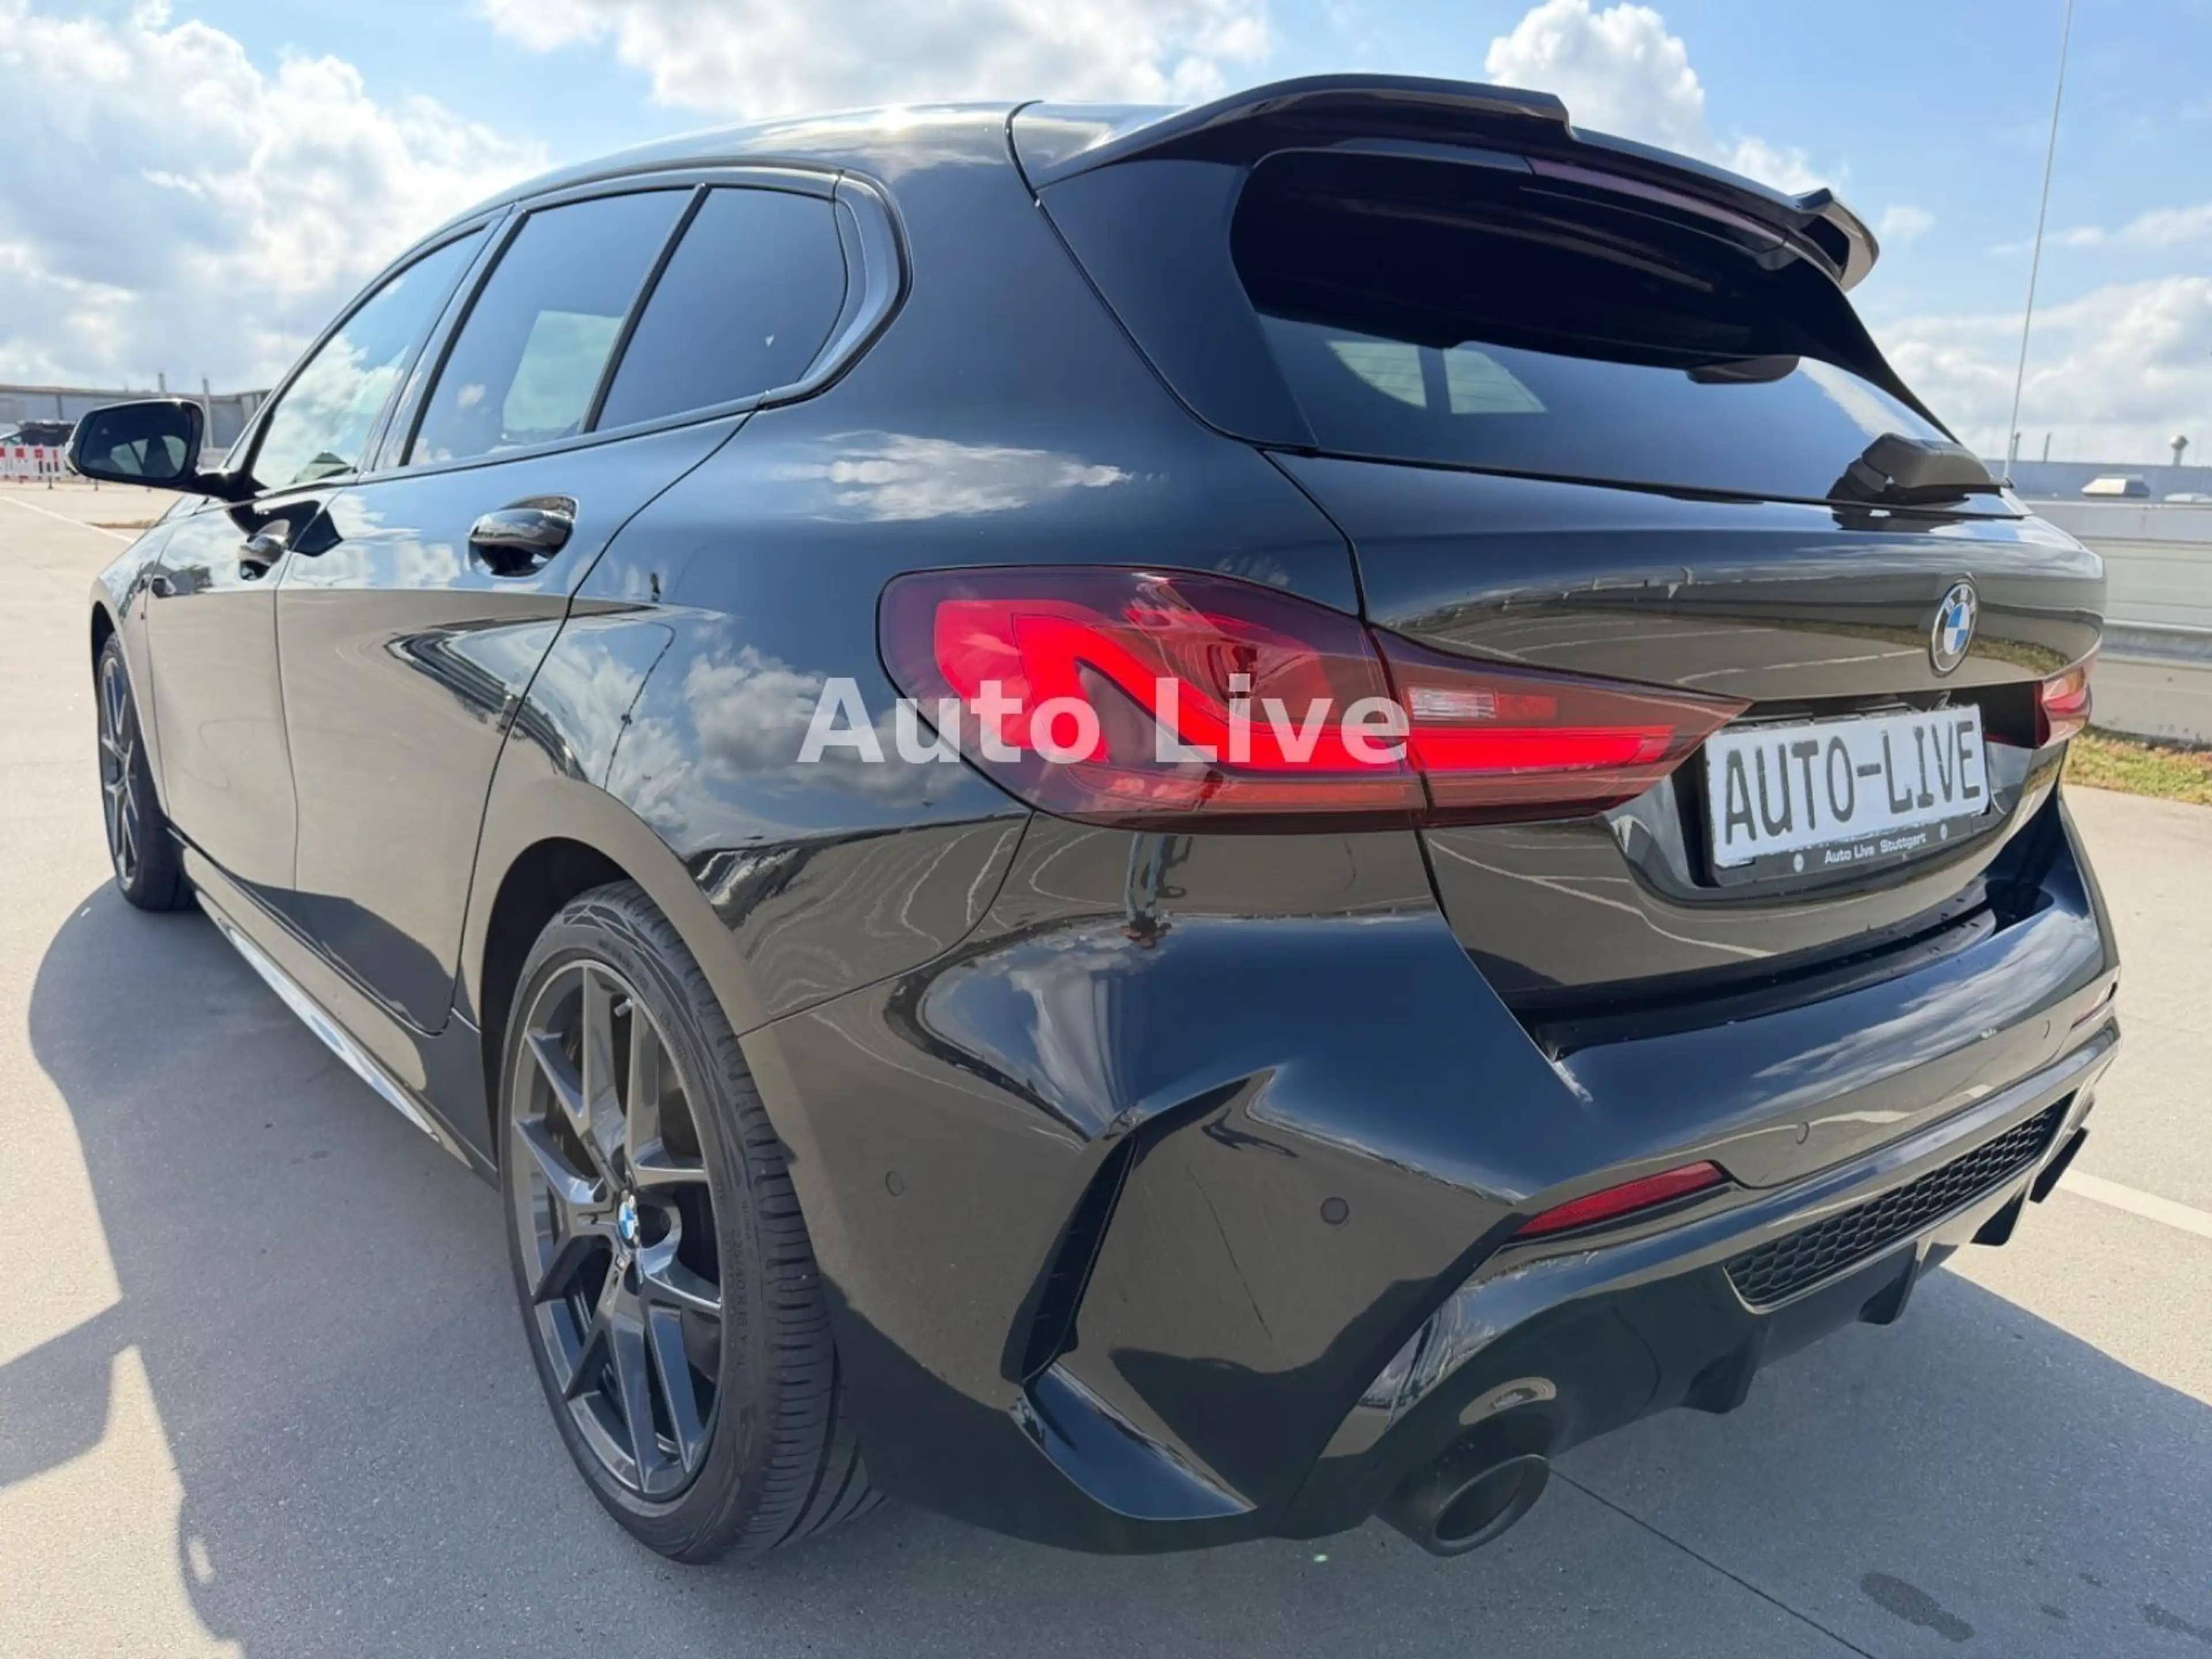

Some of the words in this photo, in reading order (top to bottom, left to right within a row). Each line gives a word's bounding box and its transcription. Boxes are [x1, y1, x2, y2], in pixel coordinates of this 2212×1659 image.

[1725, 720, 1980, 845] AUTO-LIVE
[1824, 849, 1851, 864] Auto
[1854, 844, 1874, 859] Live
[1880, 832, 1927, 854] Stuttgart
